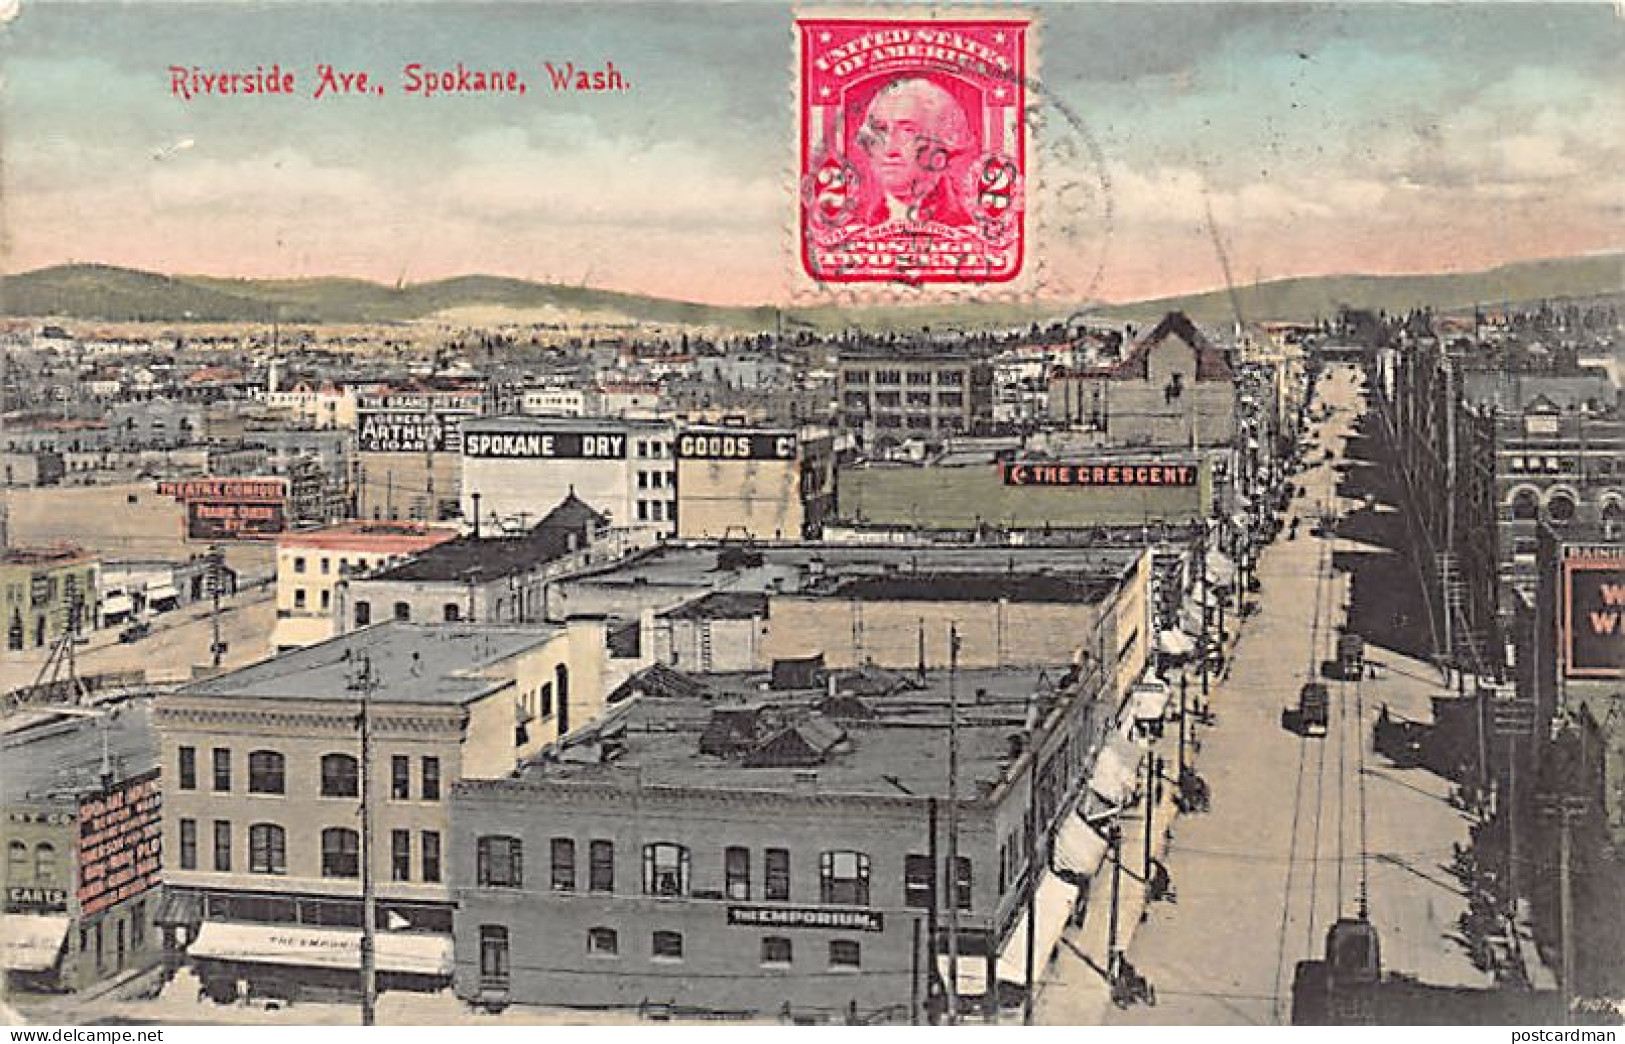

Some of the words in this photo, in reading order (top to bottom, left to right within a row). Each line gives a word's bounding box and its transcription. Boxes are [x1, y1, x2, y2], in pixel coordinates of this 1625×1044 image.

[814, 29, 910, 70] UNITED
[916, 29, 1012, 72] STATES
[362, 416, 442, 440] ARTHUR
[467, 434, 555, 456] SPOKANE
[582, 435, 623, 457] DRY
[681, 435, 751, 457] GOODS
[1034, 466, 1071, 484] THE
